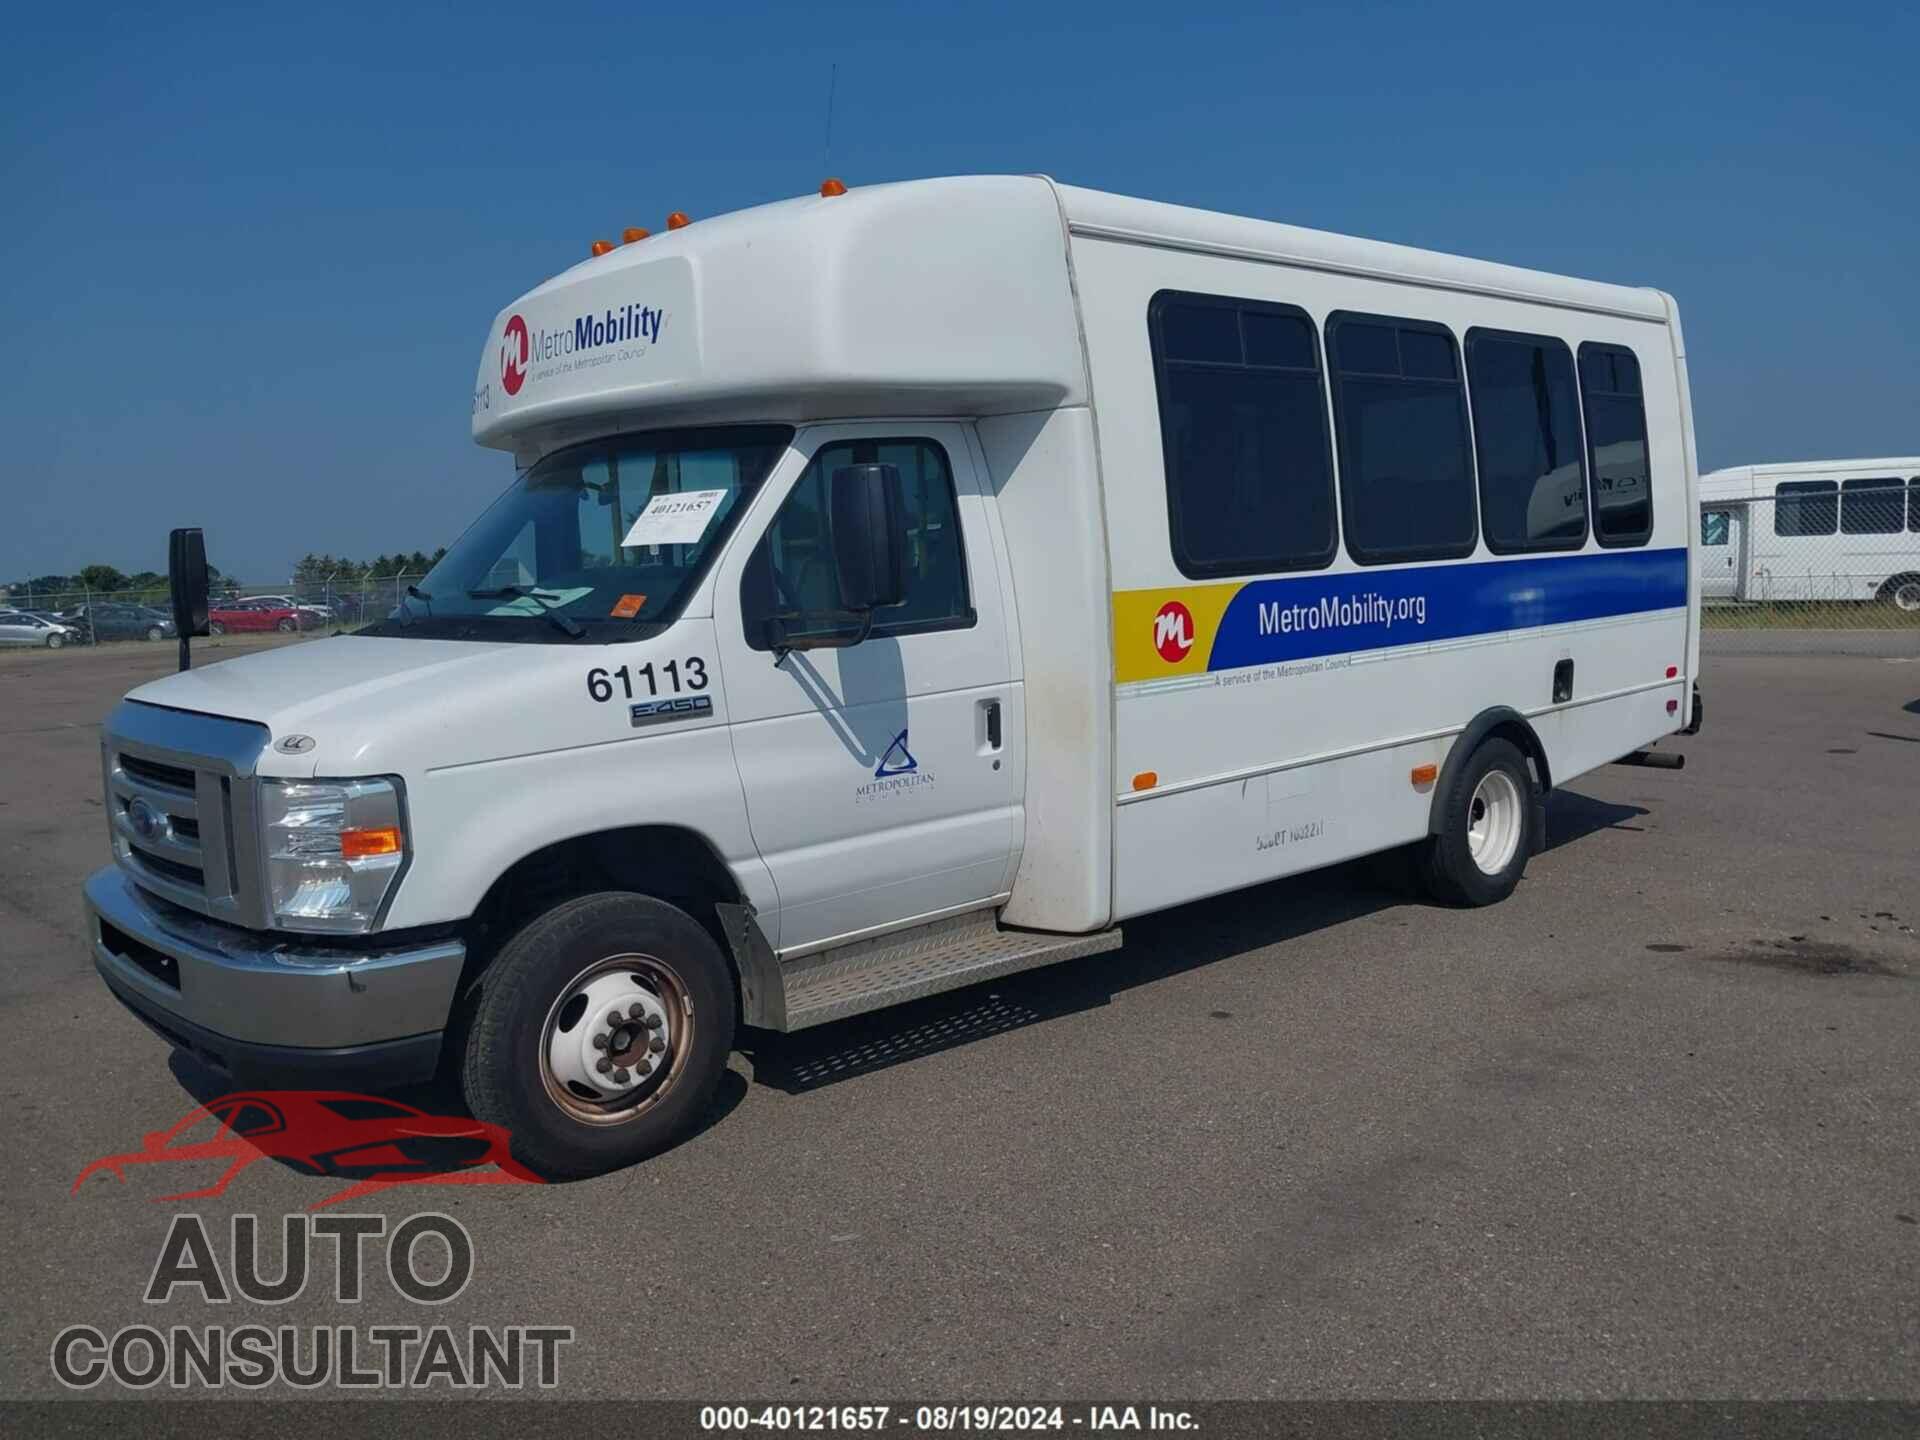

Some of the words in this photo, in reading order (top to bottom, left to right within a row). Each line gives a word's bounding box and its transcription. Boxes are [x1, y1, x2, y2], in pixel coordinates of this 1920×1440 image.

[532, 303, 662, 364] MetroMobility
[651, 500, 712, 514] 40121657
[1258, 592, 1426, 636] MetroMobility.org
[587, 657, 709, 703] 61113
[1214, 672, 1221, 687] A
[1222, 670, 1252, 687] service
[1253, 668, 1261, 681] of
[1262, 666, 1276, 680] the
[1277, 660, 1324, 677] Metropolitan
[856, 773, 936, 796] METROPOLITAN
